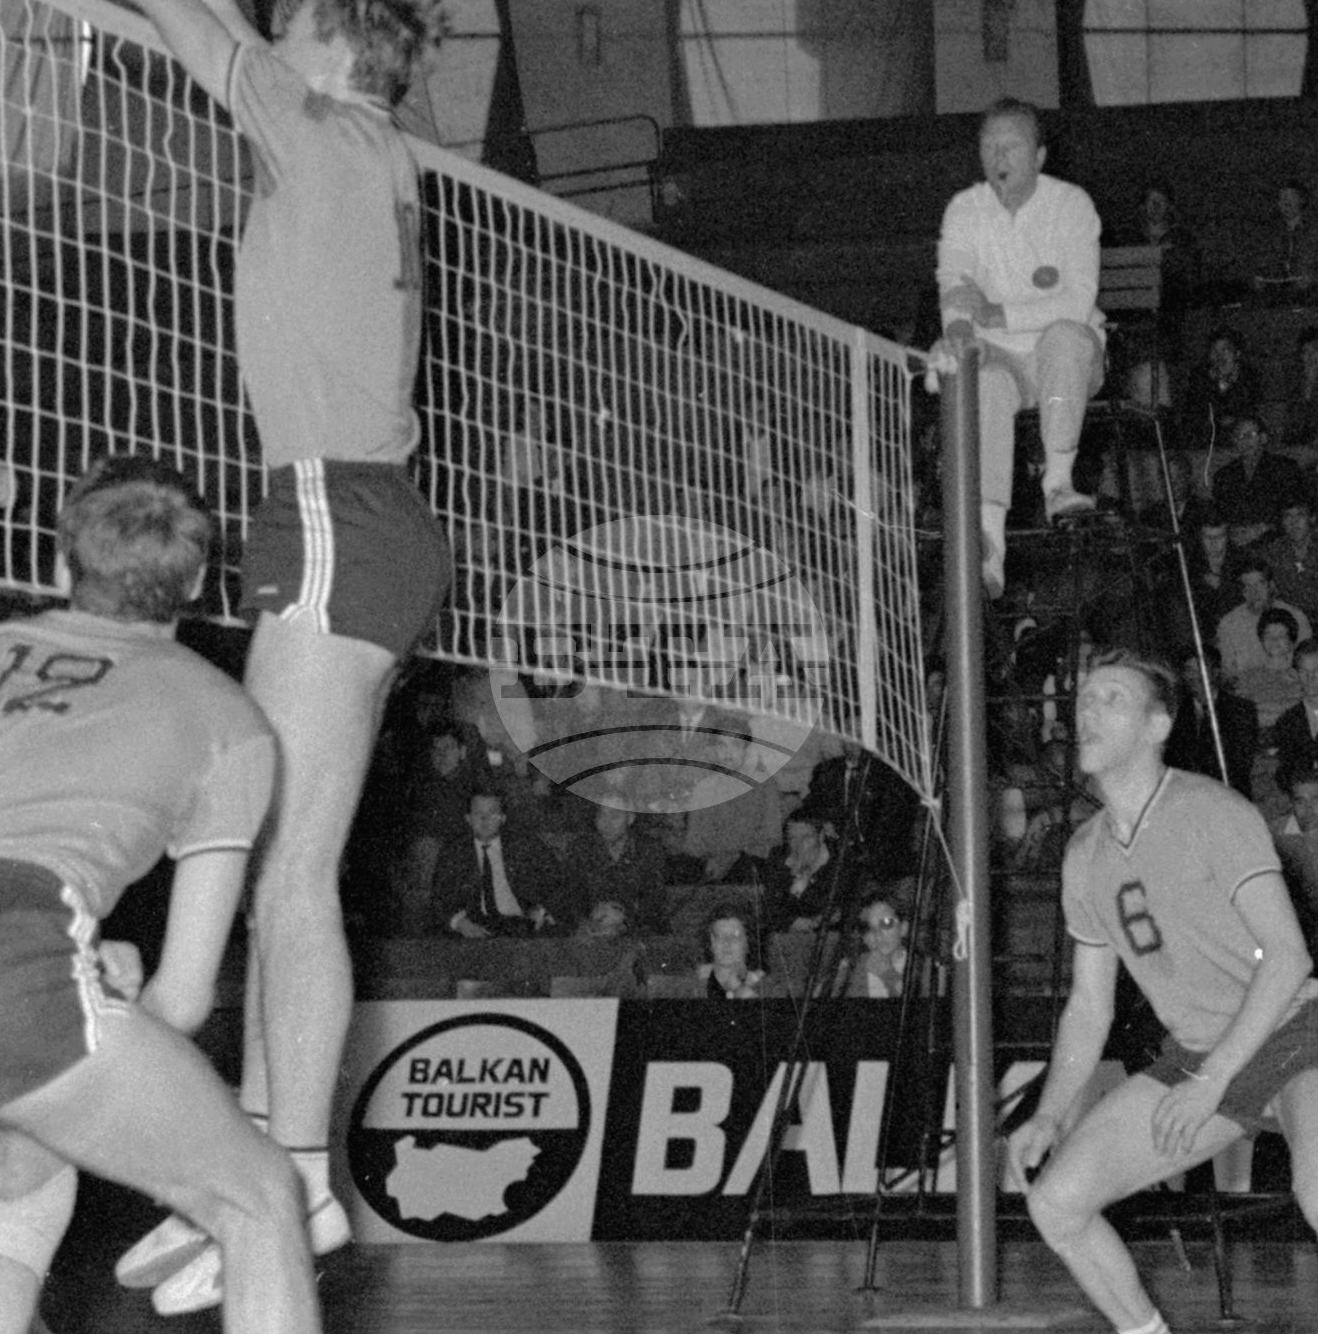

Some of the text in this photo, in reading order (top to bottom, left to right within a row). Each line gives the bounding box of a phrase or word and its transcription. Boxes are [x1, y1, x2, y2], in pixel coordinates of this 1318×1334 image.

[1116, 880, 1163, 956] 6
[409, 1058, 550, 1084] BALKAN
[401, 1092, 550, 1117] TOURIST
